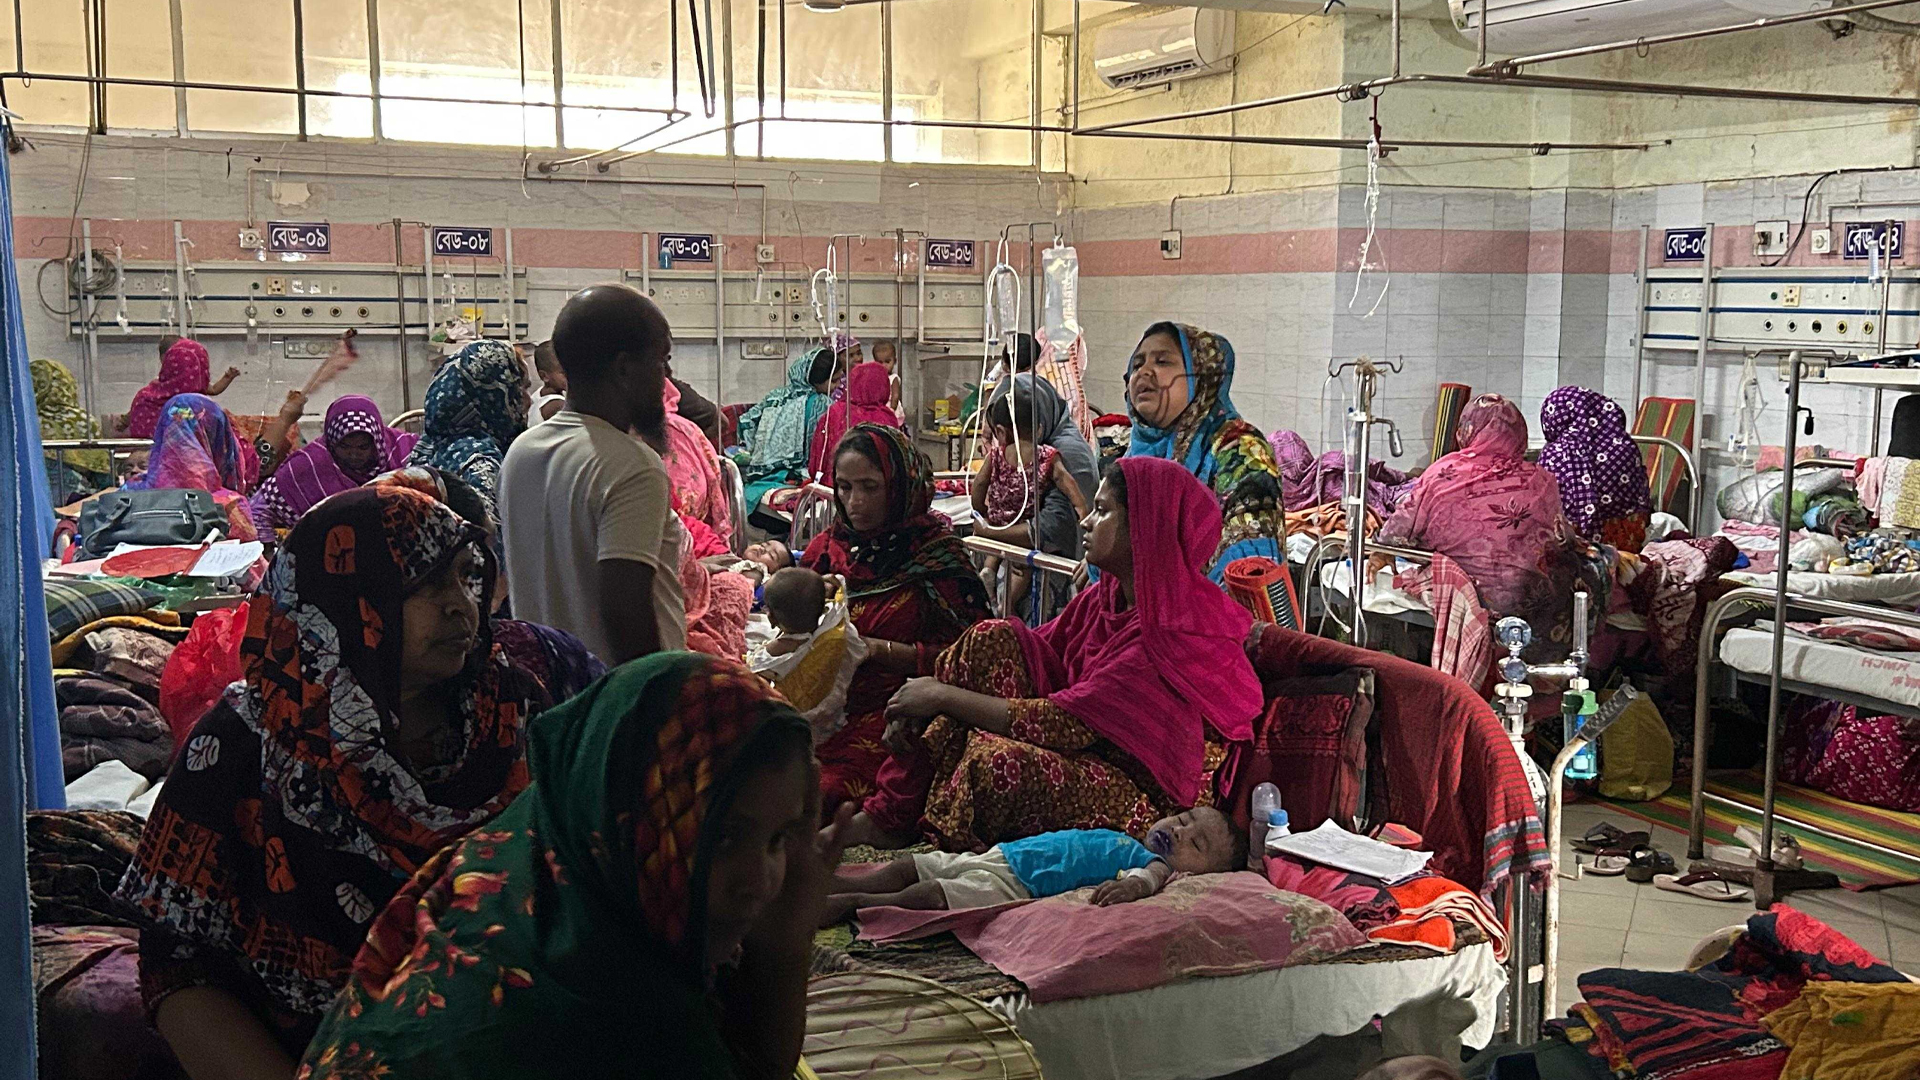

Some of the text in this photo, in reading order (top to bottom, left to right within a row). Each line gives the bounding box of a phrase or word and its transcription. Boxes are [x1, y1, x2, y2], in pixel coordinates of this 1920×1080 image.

[272, 227, 327, 248] বেড-০৯
[436, 231, 489, 251] বেড-০৮
[929, 243, 972, 262] বেড-০৬
